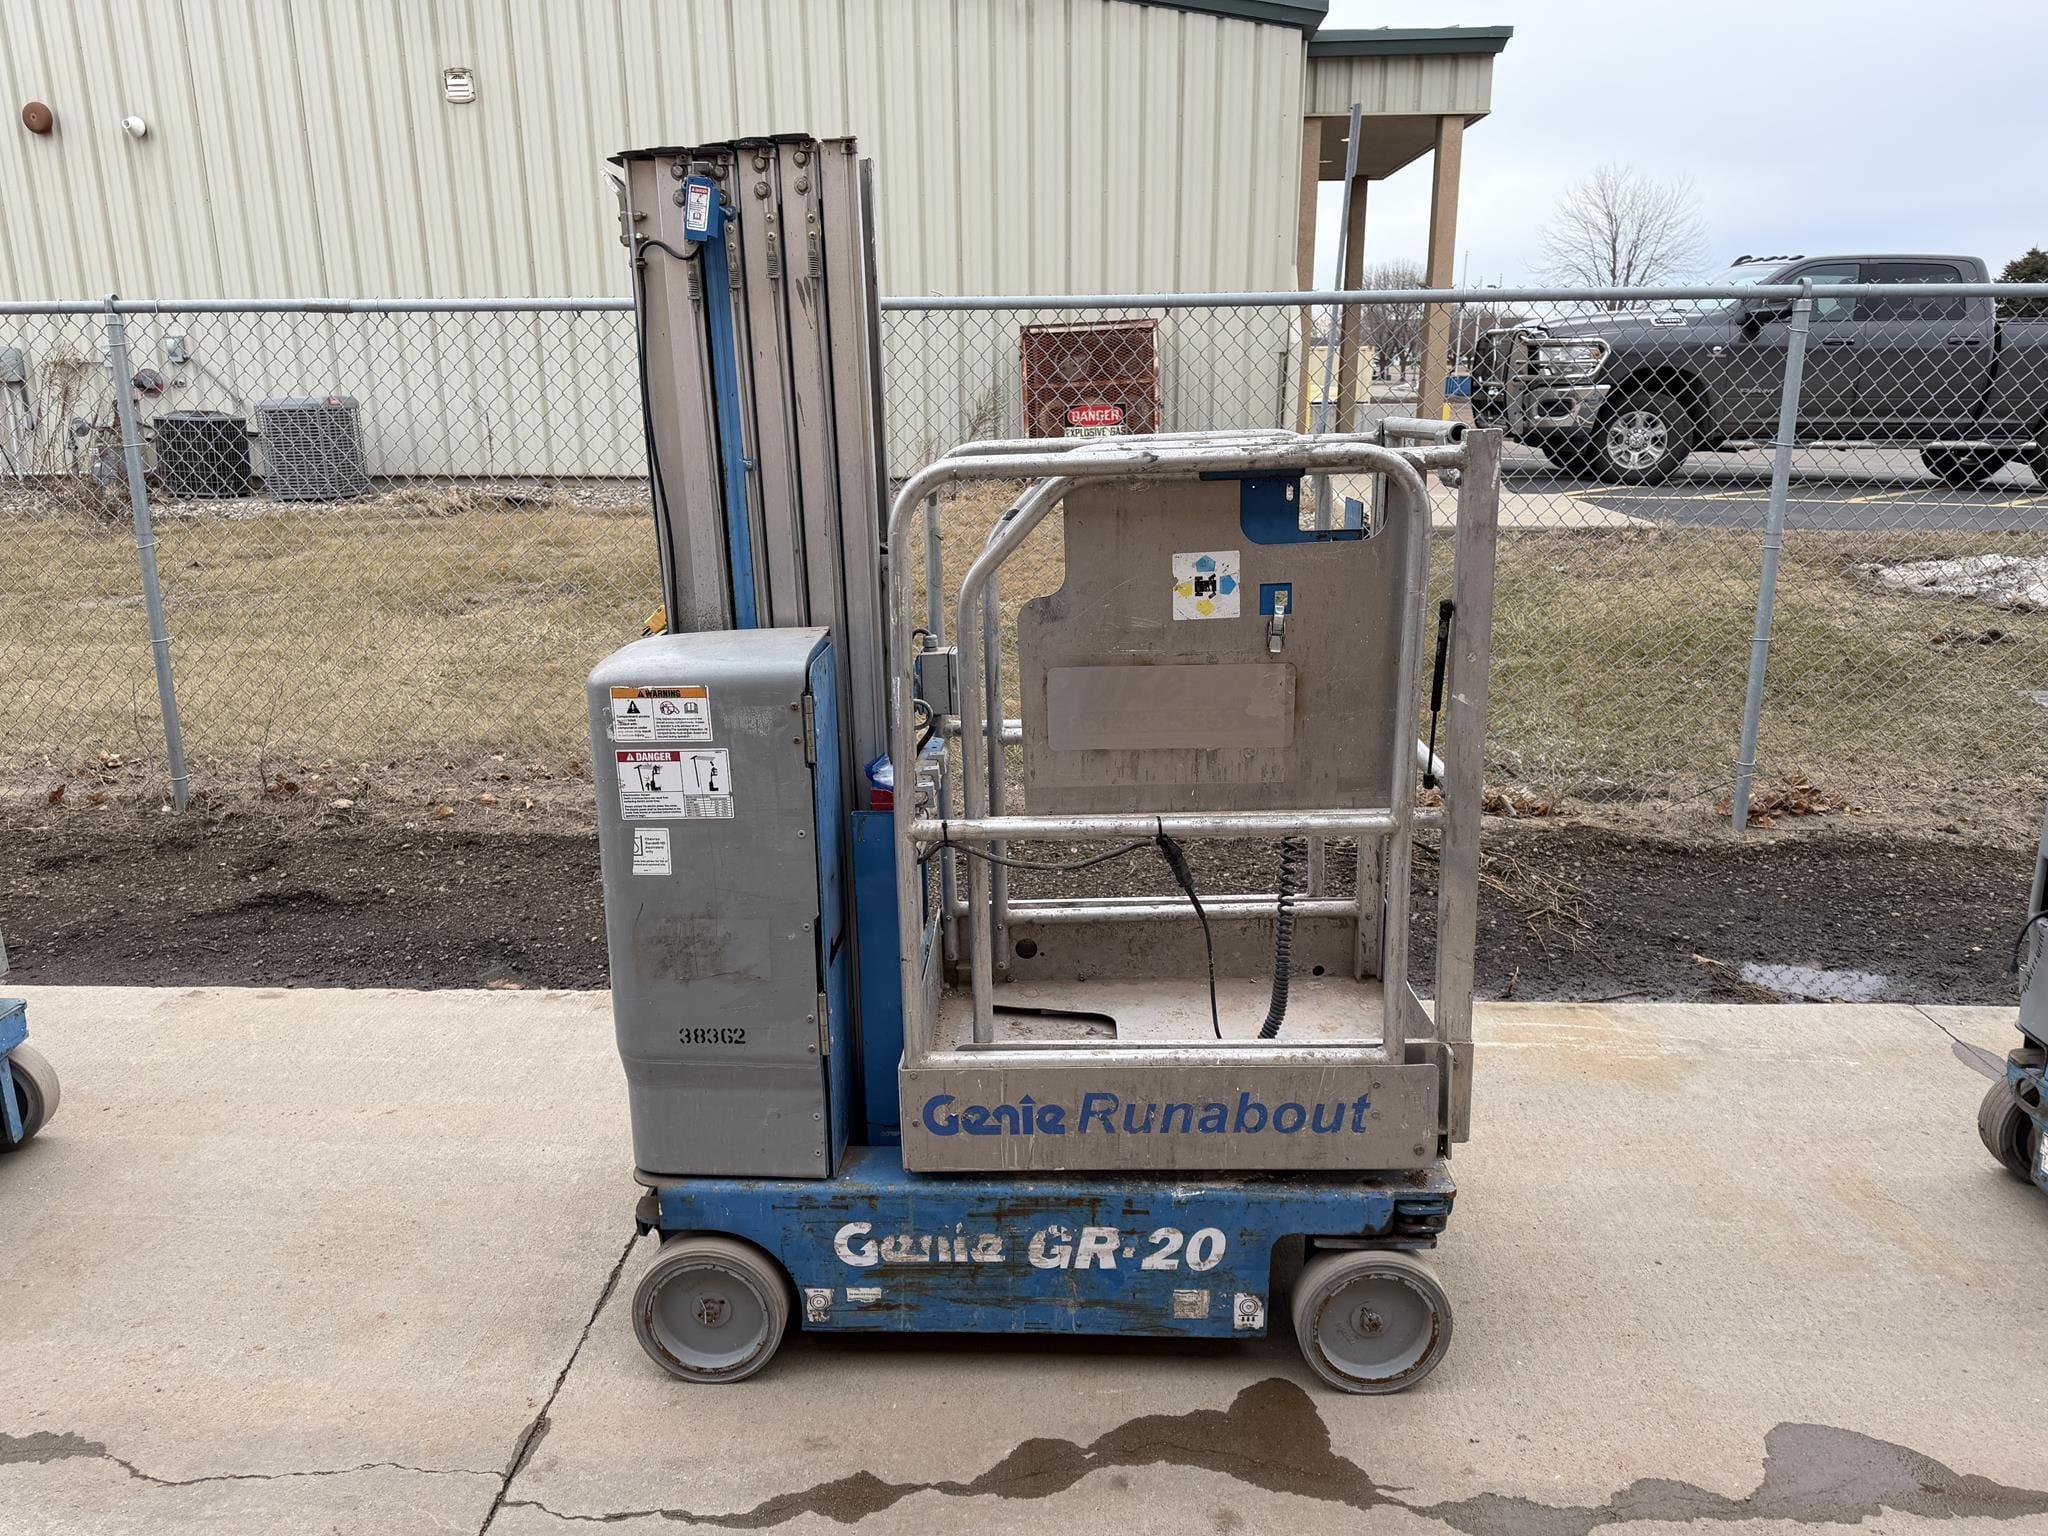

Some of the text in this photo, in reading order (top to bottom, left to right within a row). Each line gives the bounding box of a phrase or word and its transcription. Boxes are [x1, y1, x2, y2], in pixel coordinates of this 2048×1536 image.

[1071, 409, 1119, 422] DANGER
[1066, 426, 1126, 437] EXPLOSIVE GAS
[644, 690, 681, 698] WARNING
[635, 752, 672, 761] DANGER
[679, 1027, 746, 1044] 38362
[922, 1091, 1374, 1136] Genie Runabout
[833, 1221, 1227, 1272] Genie GR-20
